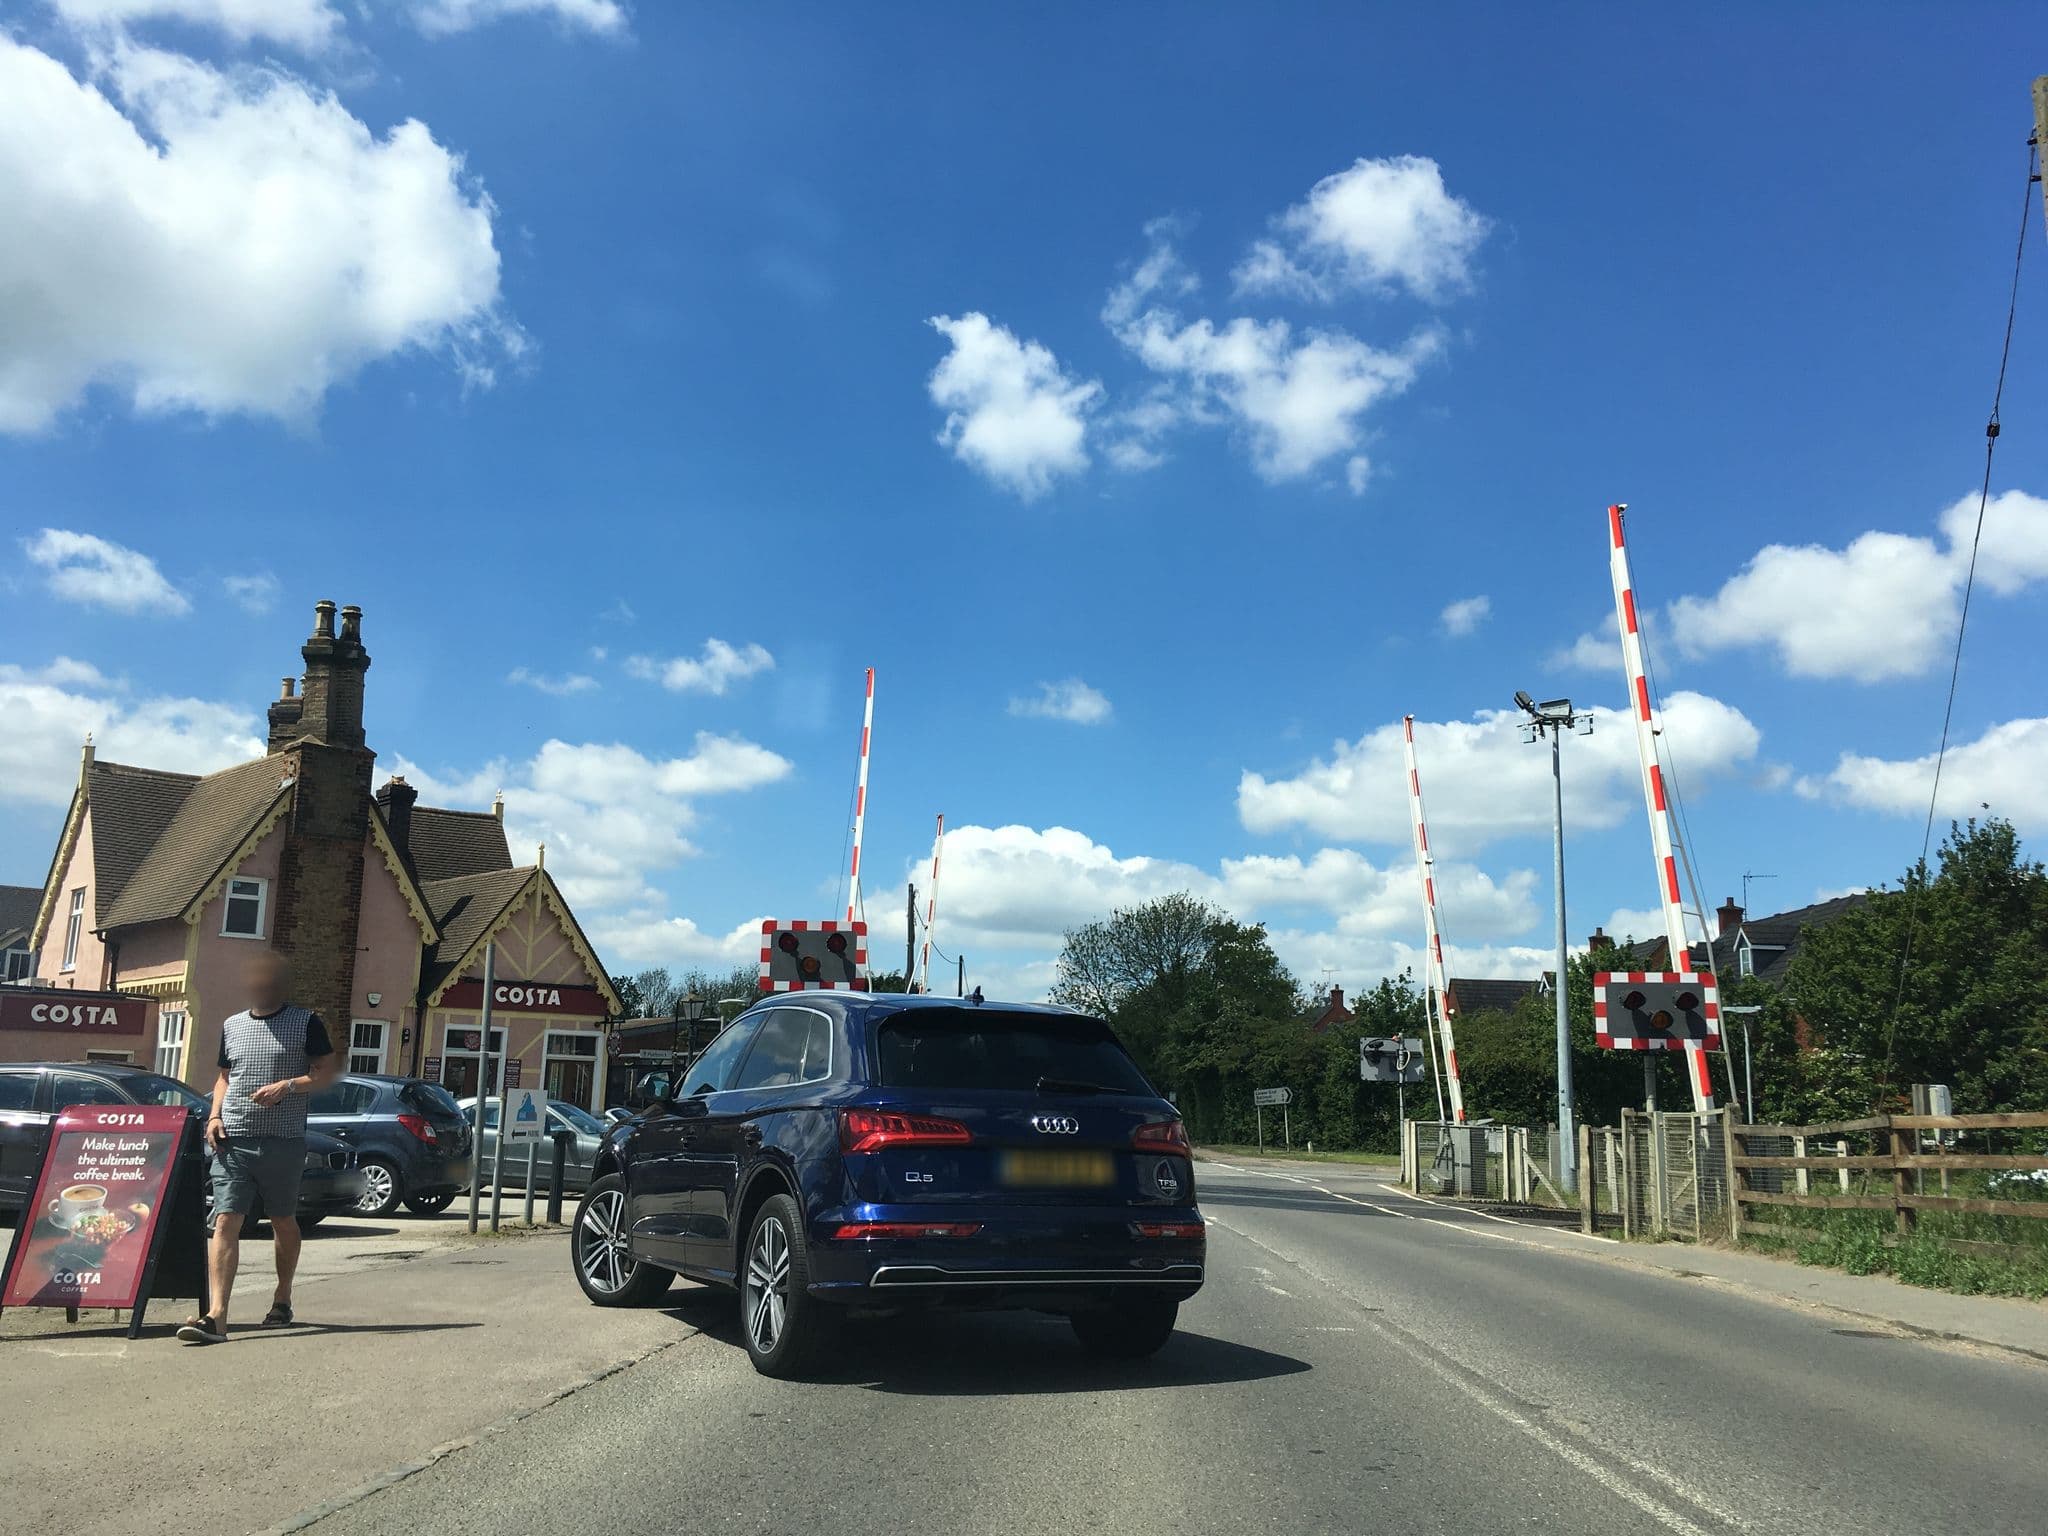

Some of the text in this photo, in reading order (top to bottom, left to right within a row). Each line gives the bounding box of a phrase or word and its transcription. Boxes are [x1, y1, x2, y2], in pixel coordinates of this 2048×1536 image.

[495, 986, 561, 1006] COSTA
[30, 1003, 118, 1027] COSTA
[97, 1113, 144, 1126] COSTA
[82, 1137, 150, 1151] Make lunch
[78, 1152, 146, 1166] the ultimate
[73, 1167, 146, 1181] coffee break.
[905, 1171, 934, 1183] Q5
[1158, 1178, 1178, 1187] TFSI
[53, 1272, 101, 1286] COSTA
